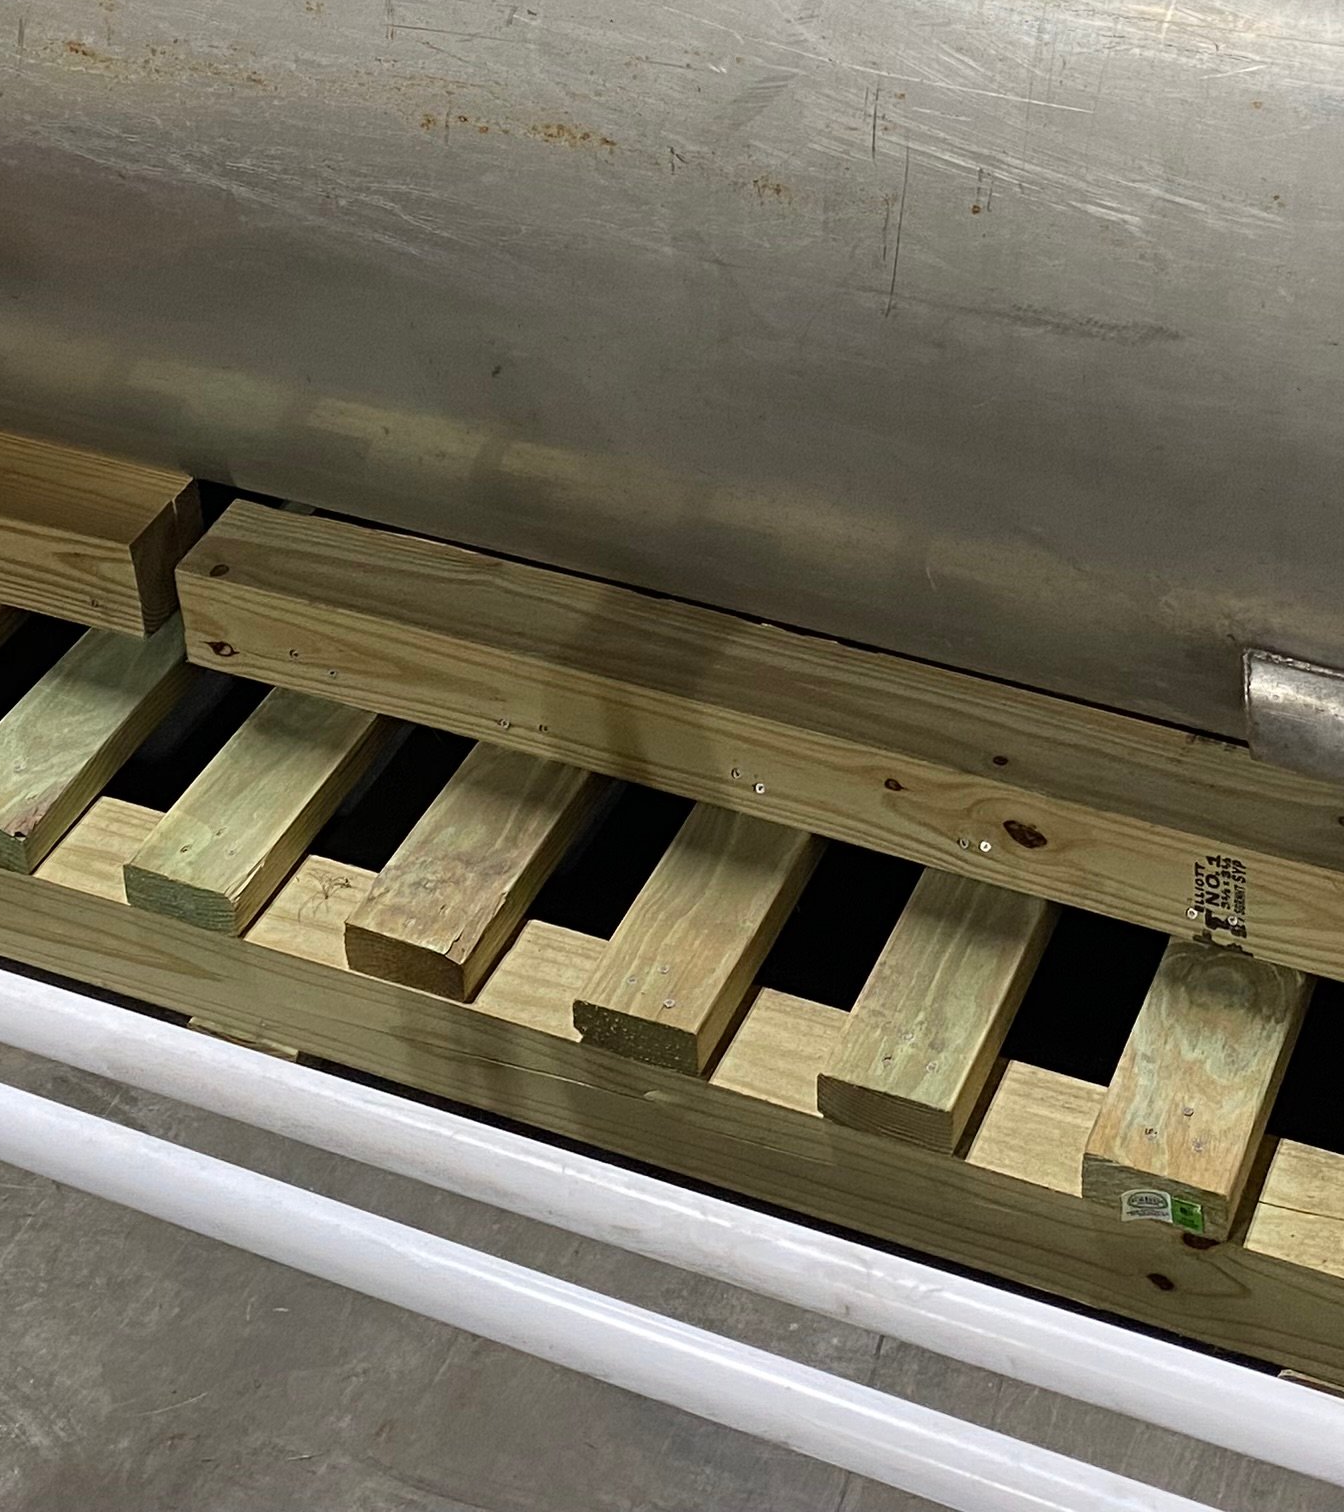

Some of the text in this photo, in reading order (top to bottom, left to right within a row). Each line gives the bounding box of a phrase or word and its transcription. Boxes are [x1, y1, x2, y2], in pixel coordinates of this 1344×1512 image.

[1205, 855, 1222, 907] NO. 1
[1231, 859, 1247, 884] SYP
